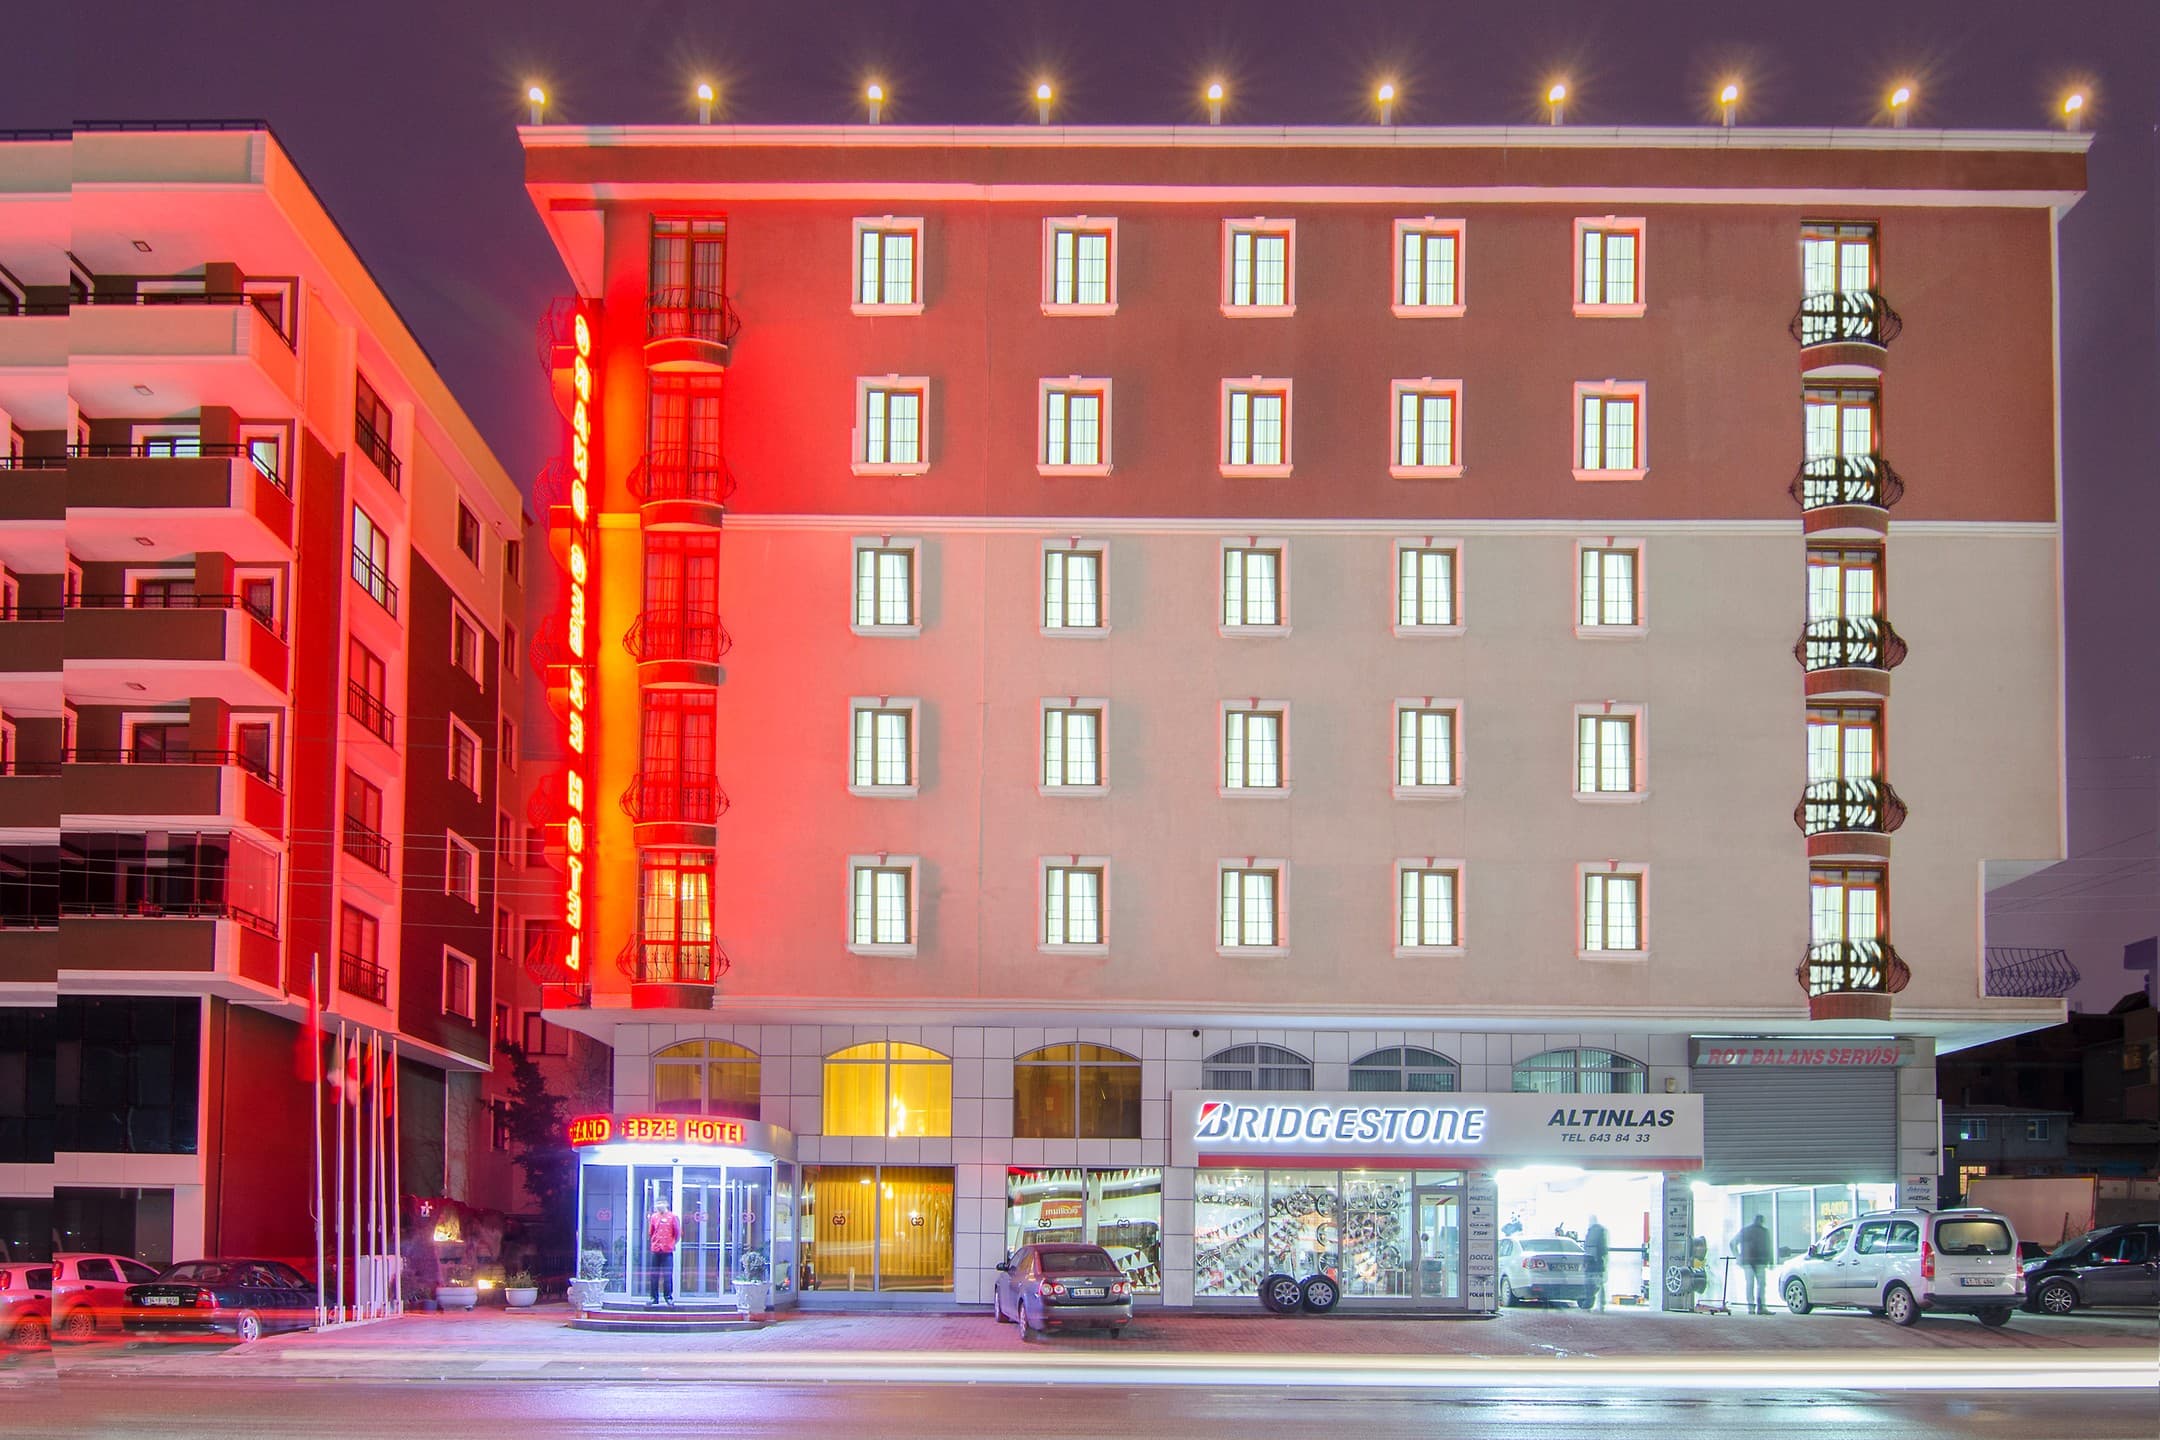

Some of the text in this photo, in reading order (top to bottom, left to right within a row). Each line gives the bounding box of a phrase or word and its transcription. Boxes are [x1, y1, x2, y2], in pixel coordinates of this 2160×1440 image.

[1708, 1048, 1747, 1065] ROT
[1752, 1047, 1826, 1065] BALANS
[1196, 1102, 1485, 1140] BRIDGESTONE
[1547, 1109, 1675, 1127] ALTINLAS
[617, 1118, 677, 1140] EBZE
[1561, 1133, 1651, 1143] TEL. 643 84 33
